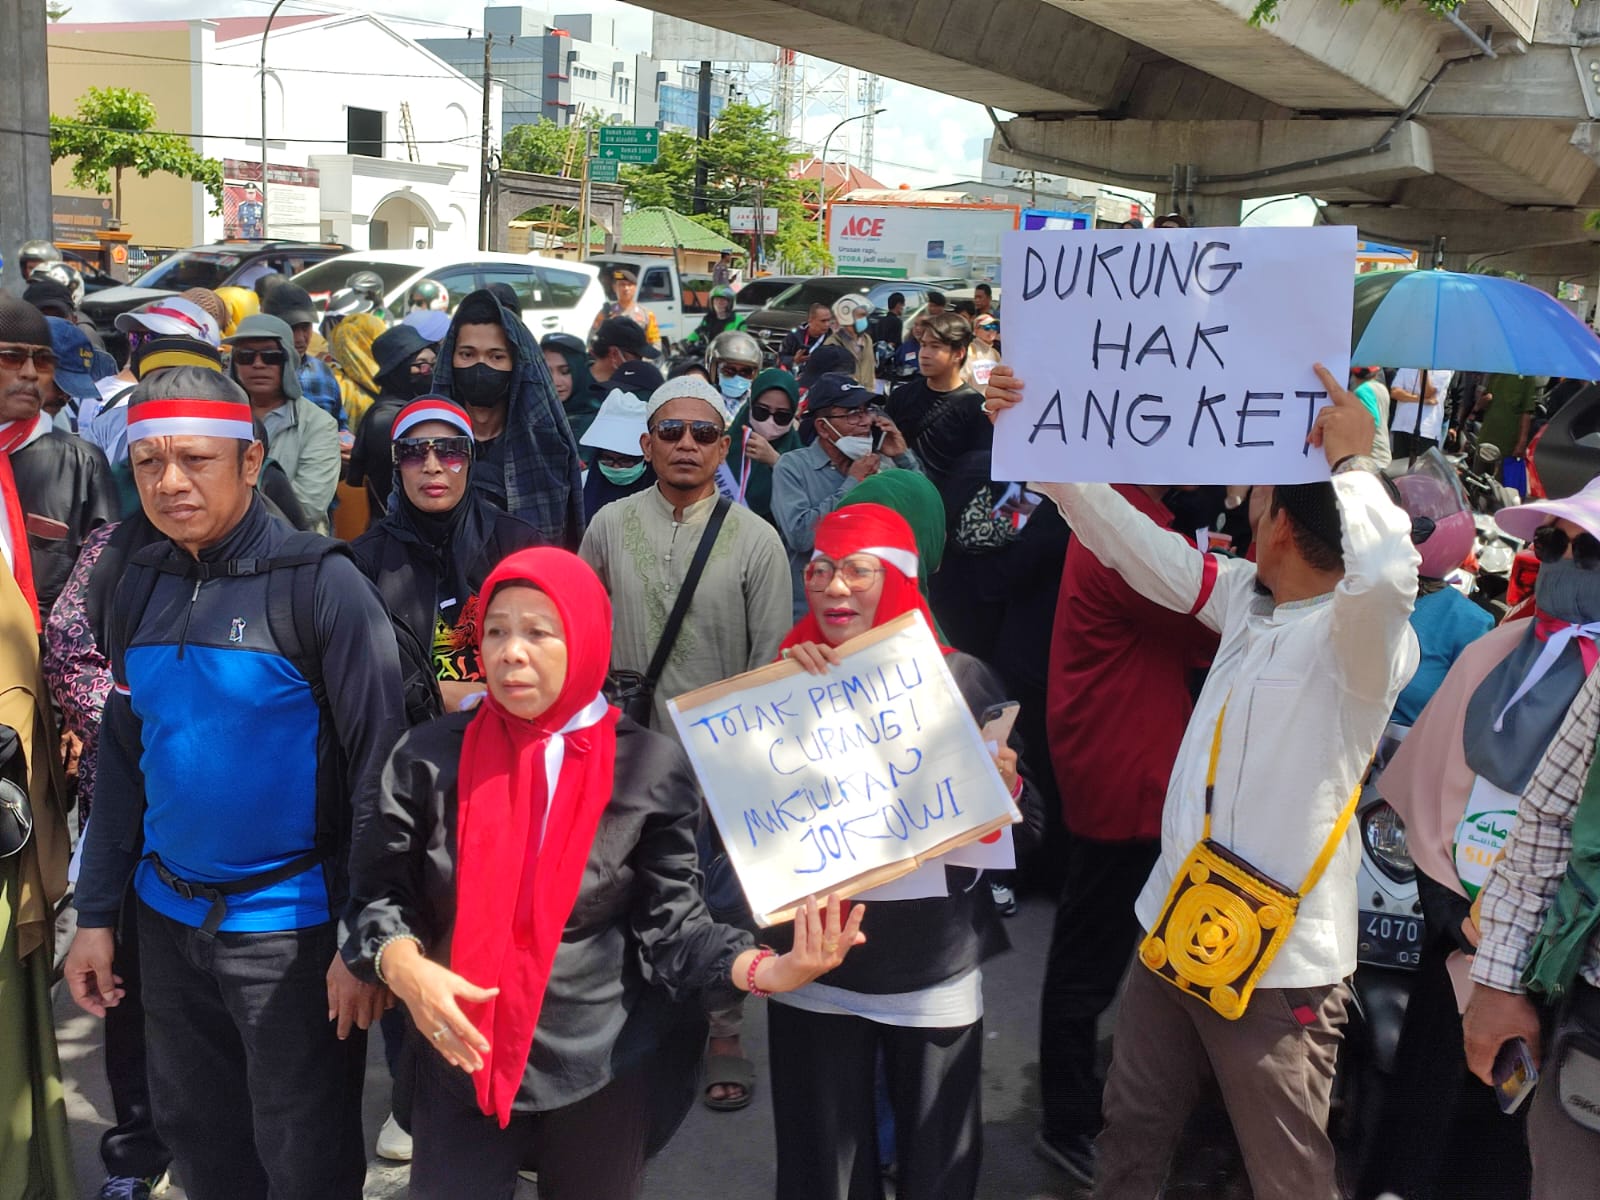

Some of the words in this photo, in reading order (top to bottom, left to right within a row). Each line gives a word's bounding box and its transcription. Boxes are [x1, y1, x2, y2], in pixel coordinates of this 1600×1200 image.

[837, 245, 861, 253] Urusan
[840, 213, 886, 237] ACE
[862, 255, 876, 263] jadi
[1022, 241, 1243, 301] DUKUNG
[1092, 318, 1229, 371] HAK
[1028, 385, 1328, 457] ANGKET
[690, 689, 799, 744] TOLAK
[807, 657, 923, 719] PEMILU
[794, 776, 963, 874] JOKOWI
[1366, 917, 1418, 942] 4070
